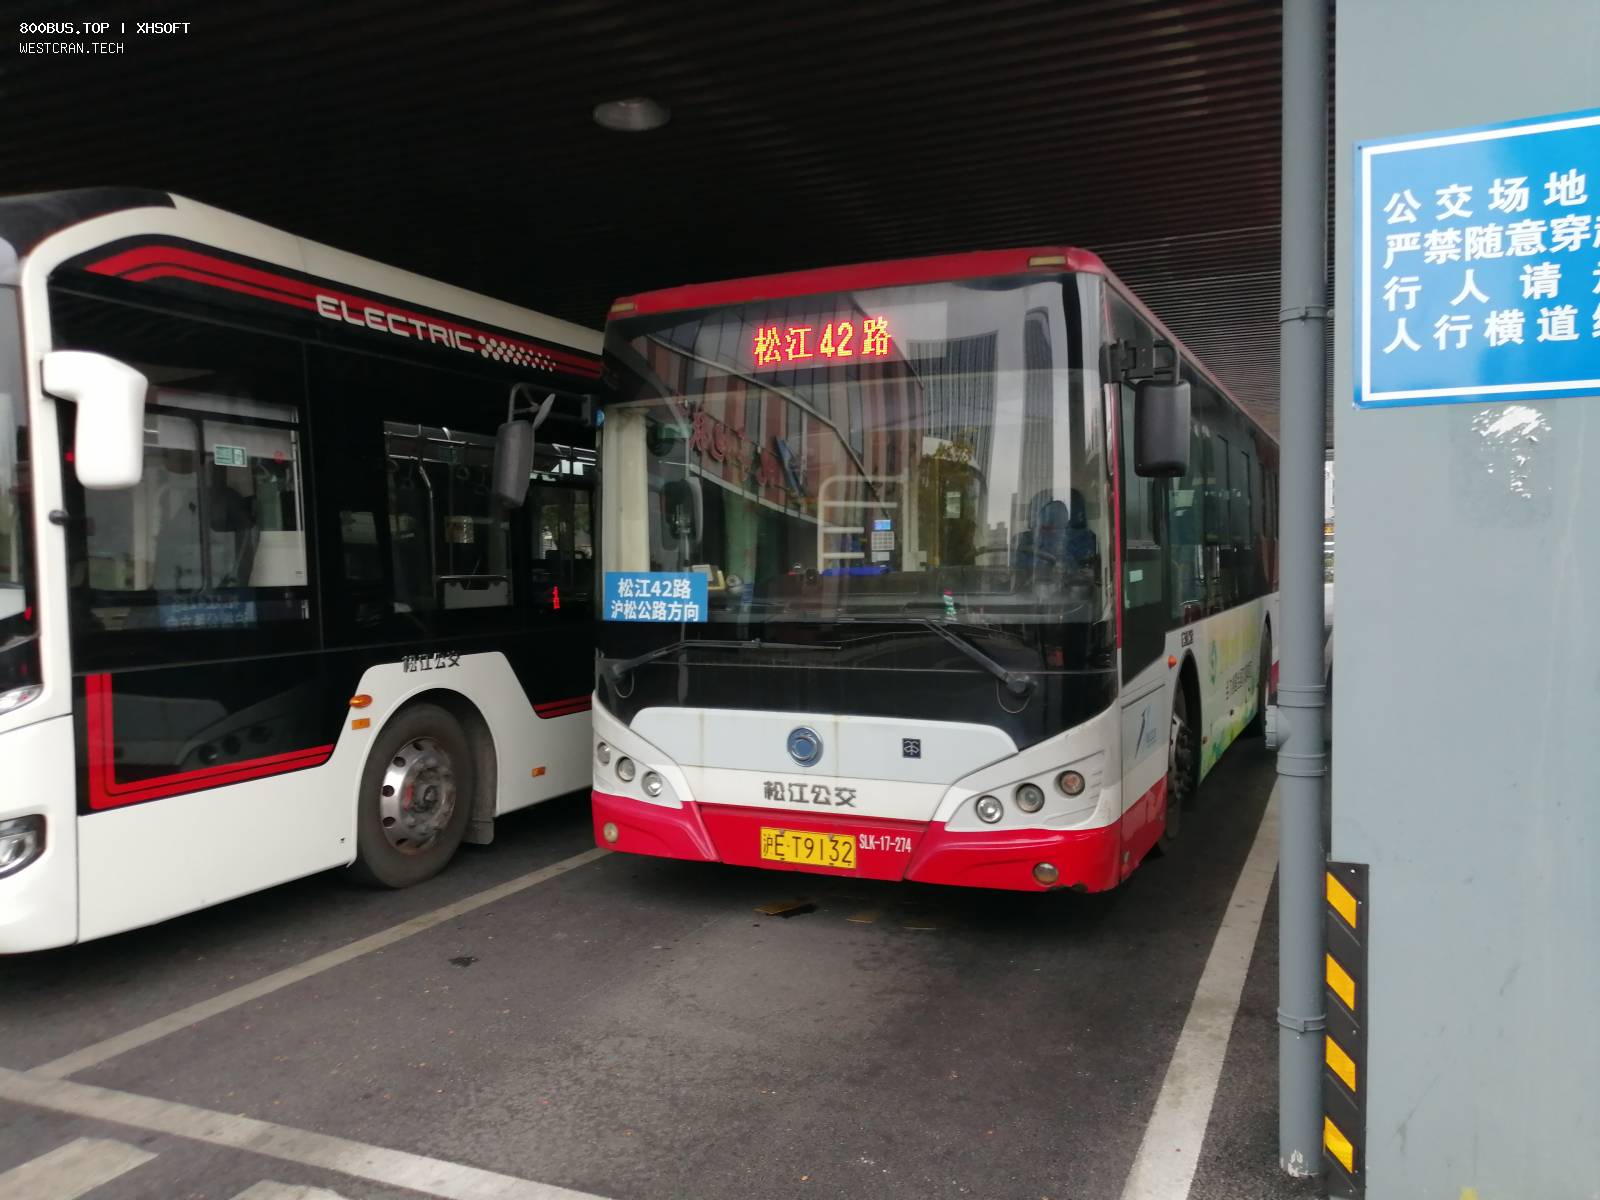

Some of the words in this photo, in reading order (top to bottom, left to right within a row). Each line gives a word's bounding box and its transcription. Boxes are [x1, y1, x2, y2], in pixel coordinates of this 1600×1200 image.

[1382, 168, 1588, 225] 公交场地
[1382, 213, 1600, 270] 严禁随意穿
[1382, 261, 1600, 312] 行人请
[316, 294, 475, 352] ELECTRIC
[1382, 303, 1600, 354] 人行横道
[610, 599, 700, 622] 沪松公路方向
[617, 578, 691, 599] 松江42路
[763, 780, 857, 808] 松江公交
[859, 833, 912, 853] SLK-17-274
